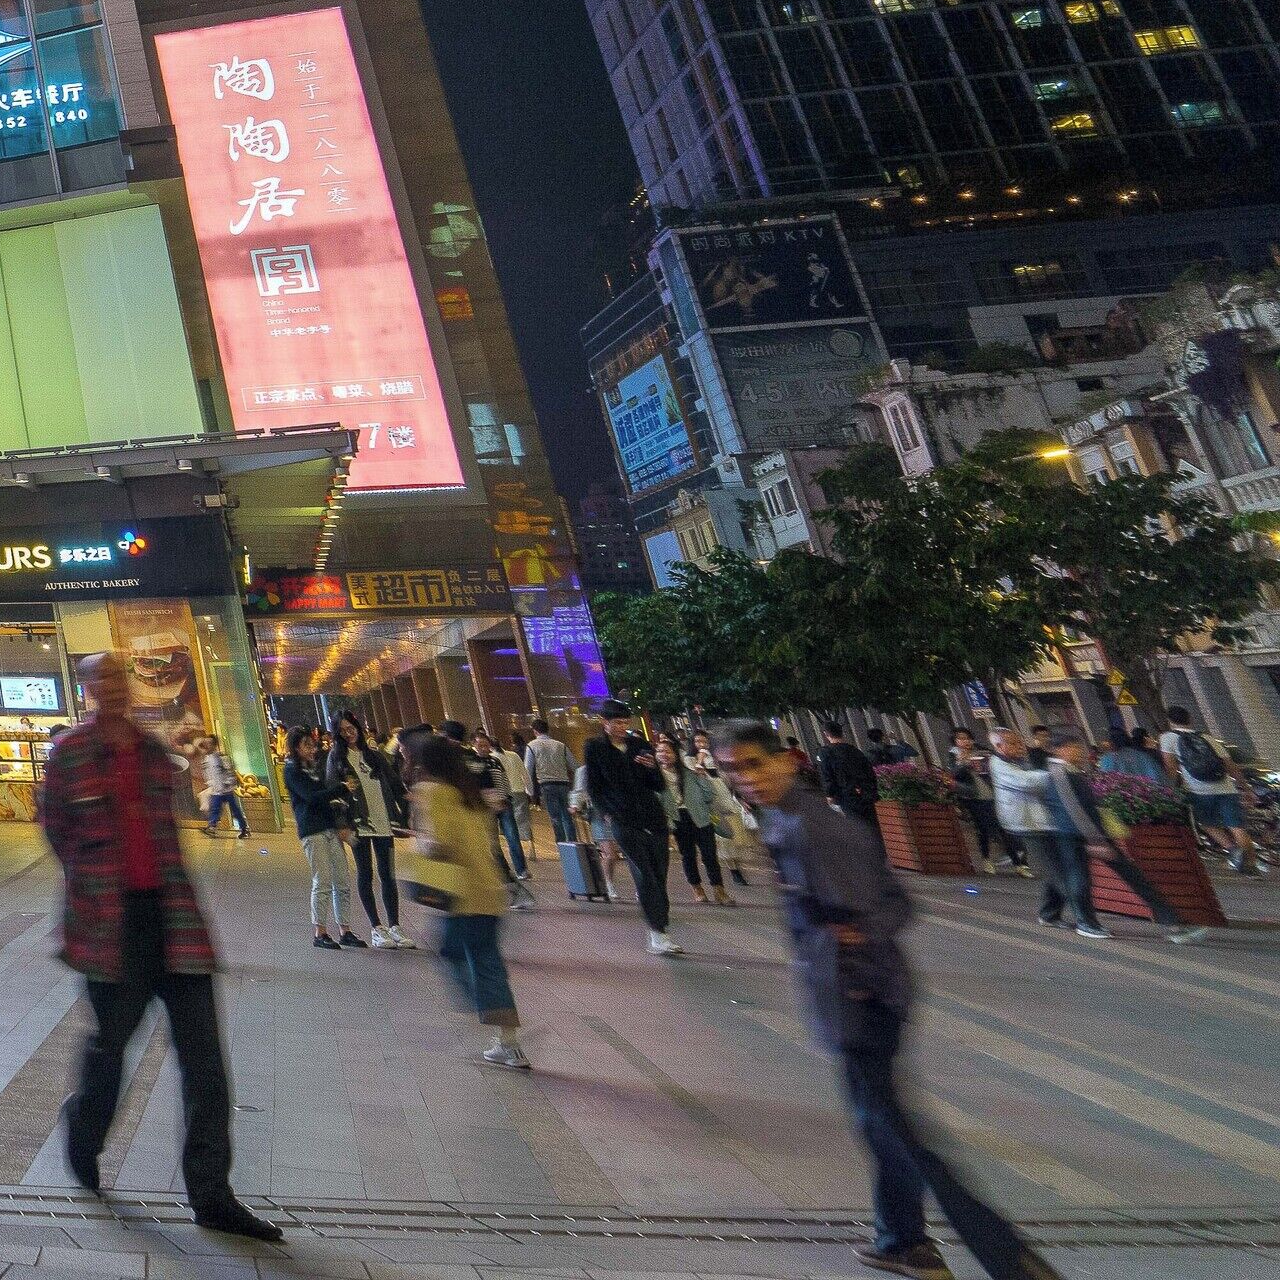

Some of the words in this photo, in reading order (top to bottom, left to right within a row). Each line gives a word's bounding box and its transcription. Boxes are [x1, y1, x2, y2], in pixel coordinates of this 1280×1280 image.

[207, 55, 307, 236] 陶陶居
[784, 227, 823, 242] KTV
[44, 580, 101, 591] AUTHENTIC
[102, 578, 140, 589] BAKERY
